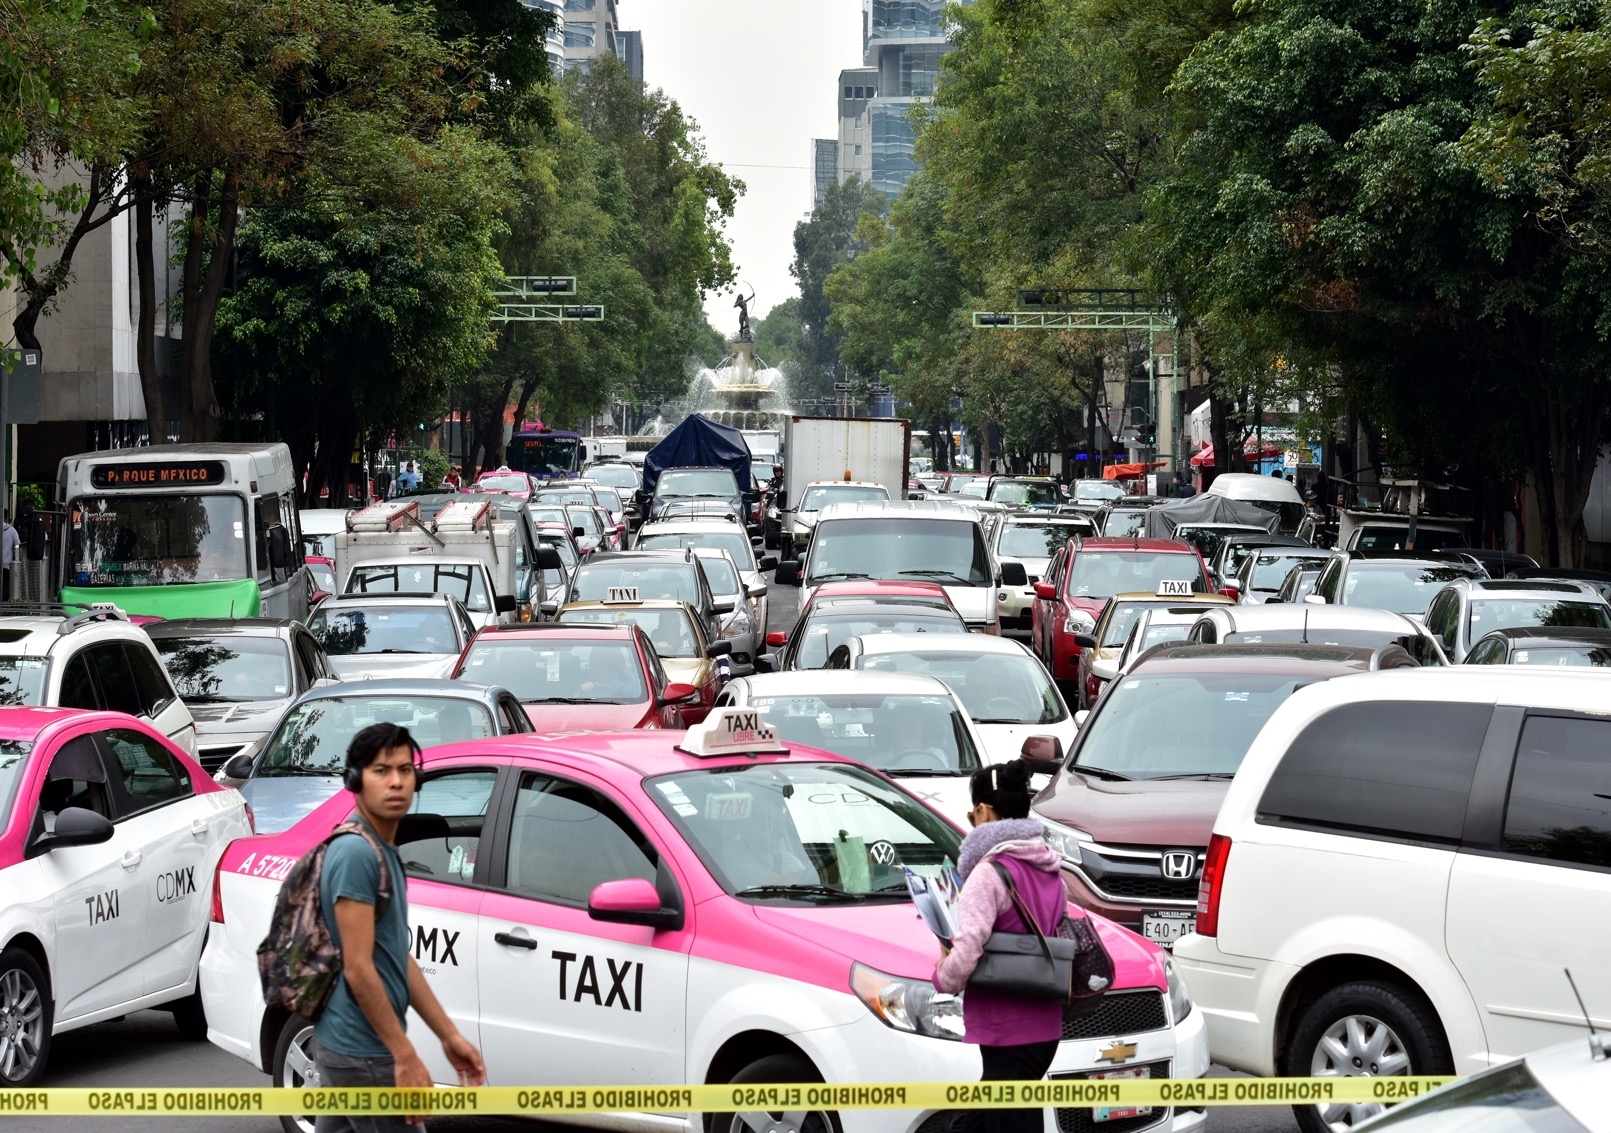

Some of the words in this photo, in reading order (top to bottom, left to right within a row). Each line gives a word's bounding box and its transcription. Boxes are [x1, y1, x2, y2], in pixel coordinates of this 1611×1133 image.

[90, 573, 115, 584] GALERIAS
[1162, 581, 1188, 594] TAXI
[609, 588, 637, 601] TAXI
[725, 713, 758, 732] TAXI
[733, 730, 755, 742] LIBRE
[237, 852, 257, 874] A
[156, 865, 196, 903] CDMX
[85, 888, 120, 926] TAXI
[407, 924, 461, 967] MX
[551, 950, 643, 1013] TAXI
